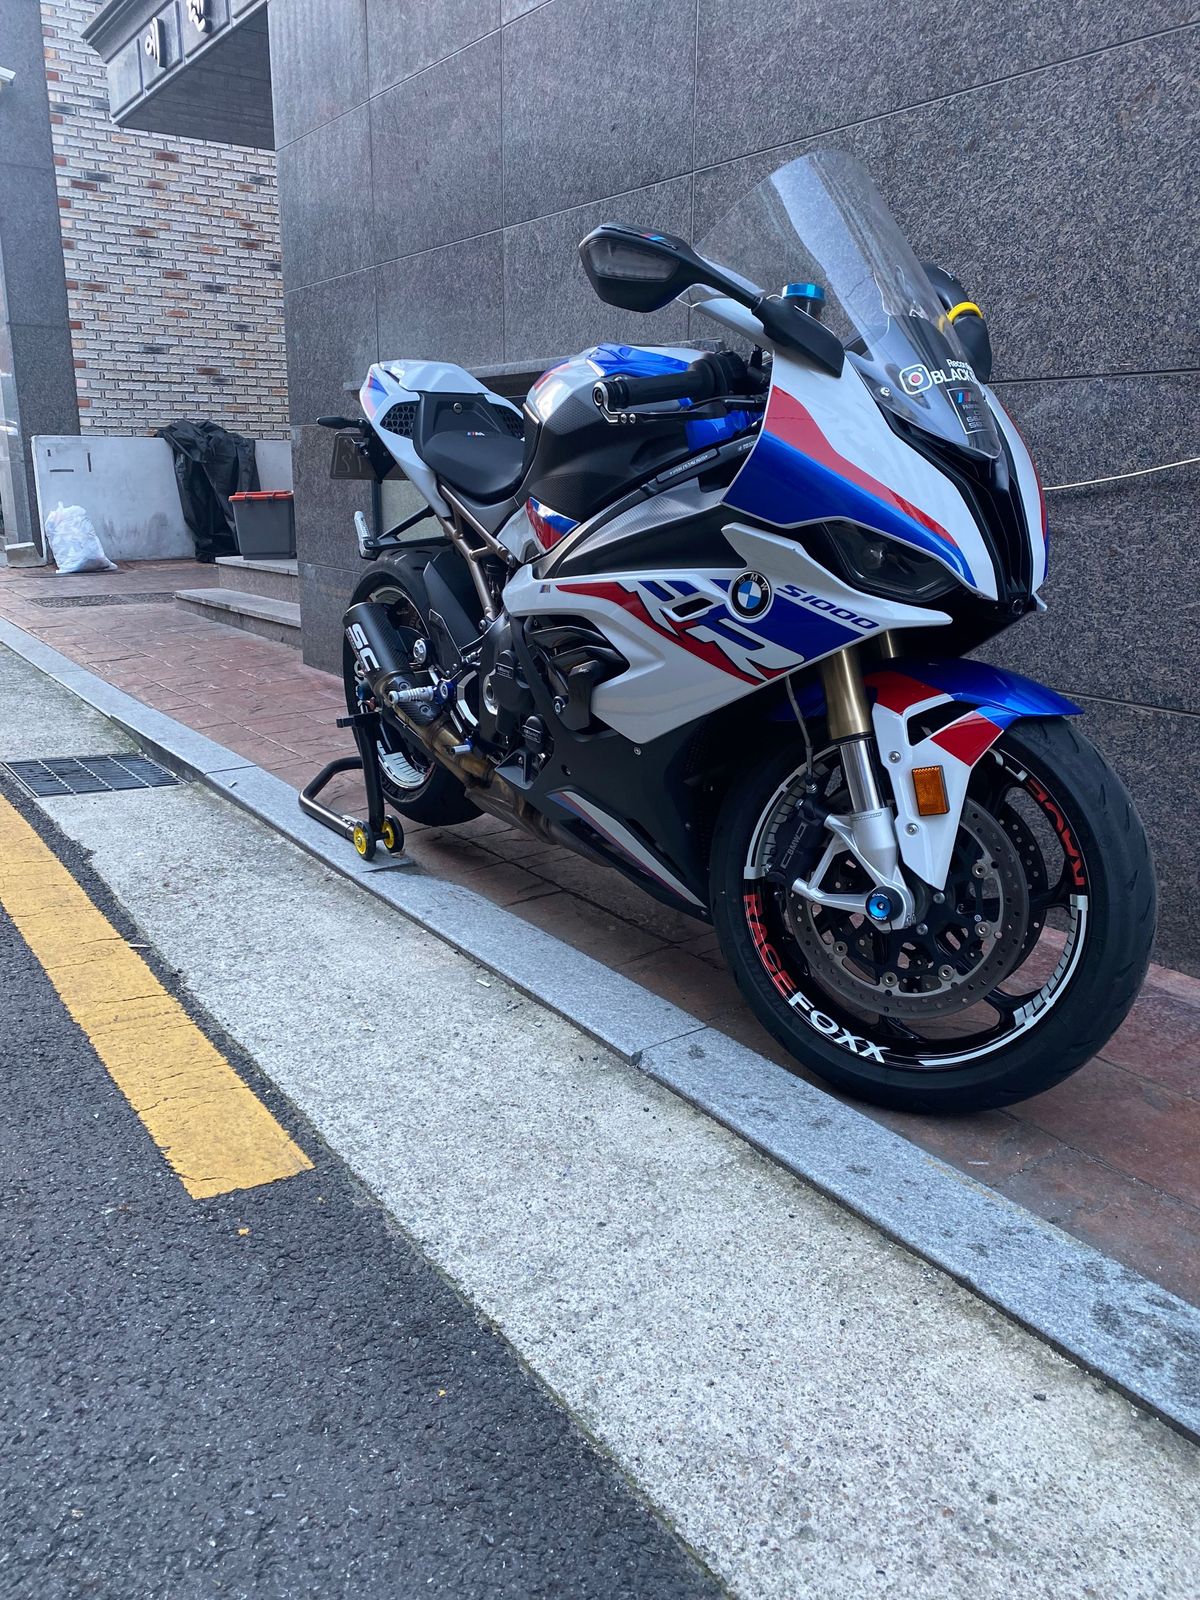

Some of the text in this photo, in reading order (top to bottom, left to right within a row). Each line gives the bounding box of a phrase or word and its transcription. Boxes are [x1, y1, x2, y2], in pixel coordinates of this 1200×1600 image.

[776, 584, 880, 629] S1000
[347, 622, 381, 672] SC
[788, 833, 802, 856] BMW
[743, 894, 891, 1063] RACE FOXX
